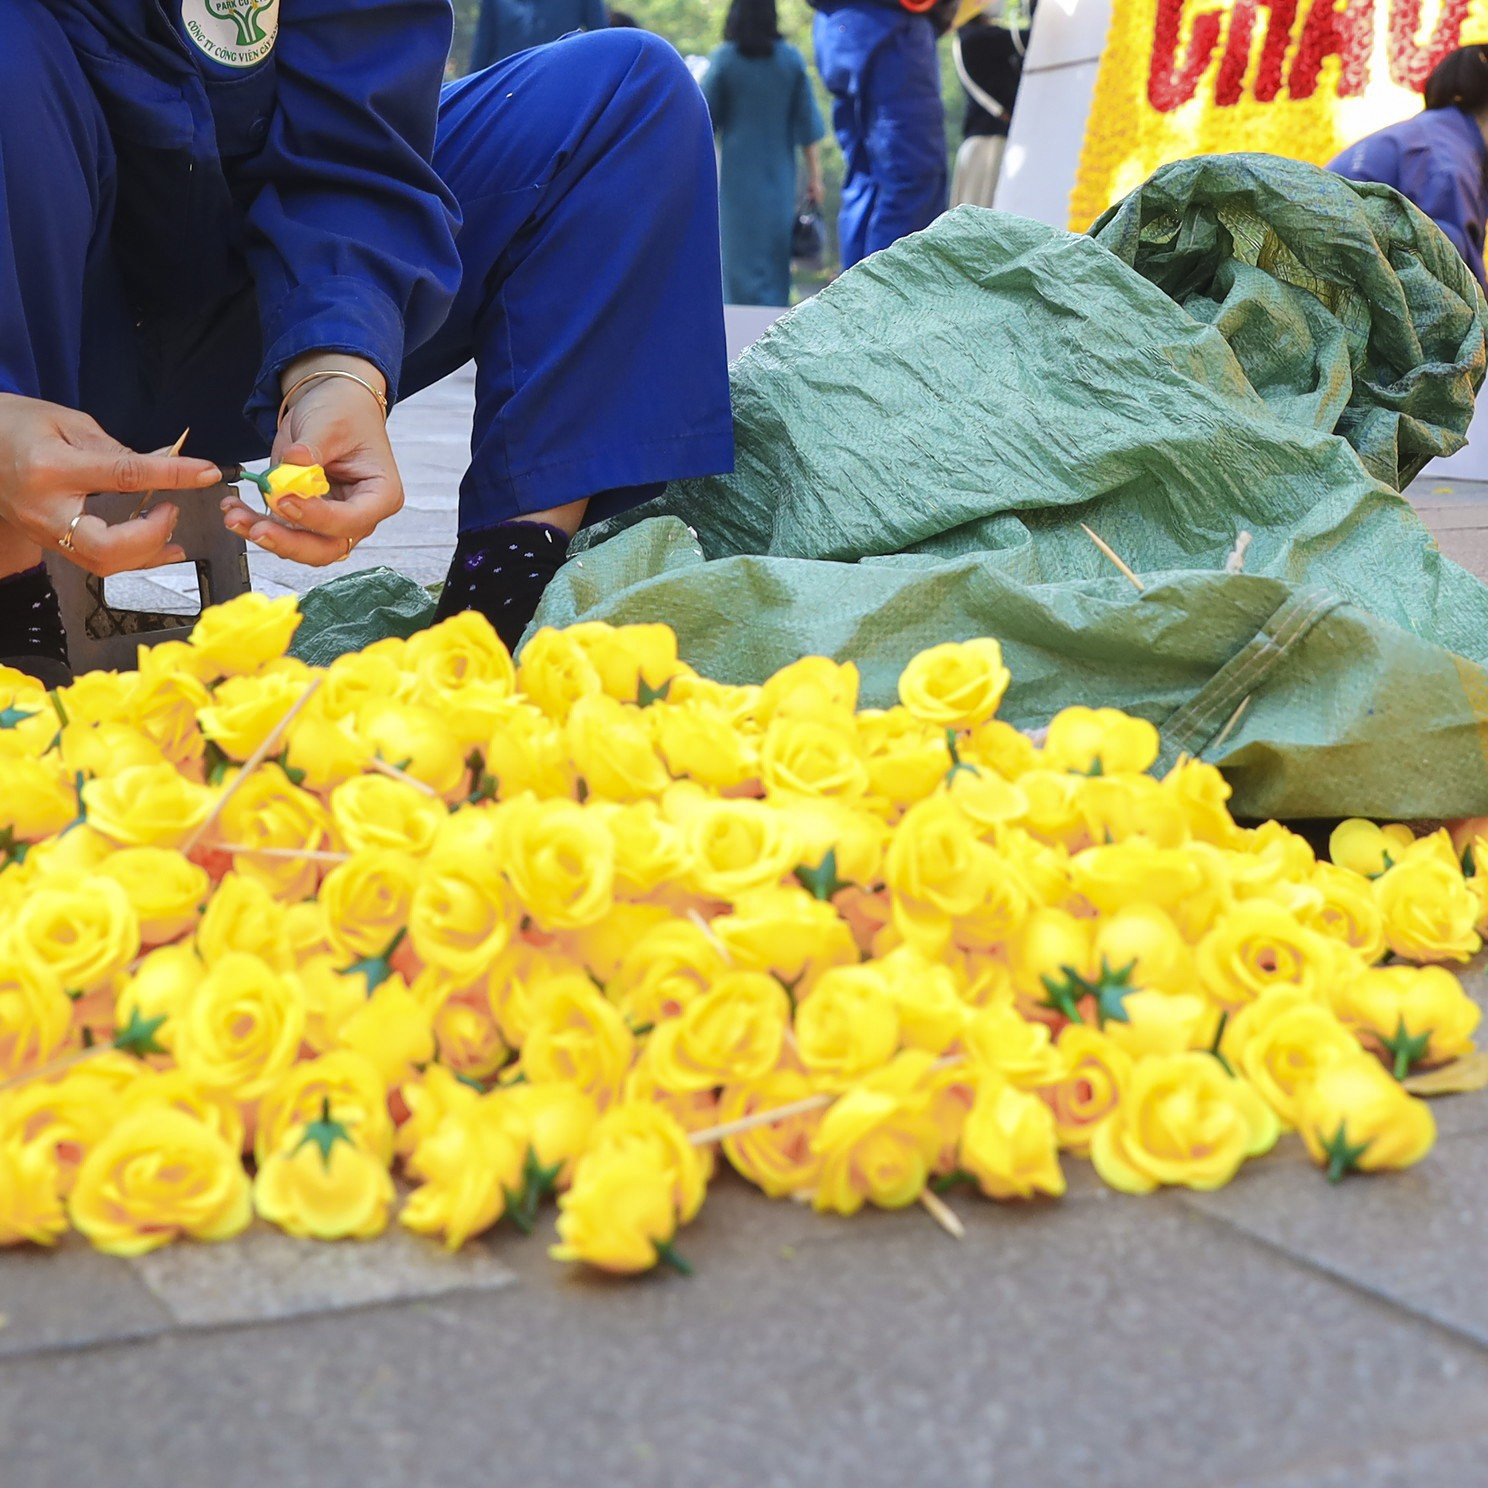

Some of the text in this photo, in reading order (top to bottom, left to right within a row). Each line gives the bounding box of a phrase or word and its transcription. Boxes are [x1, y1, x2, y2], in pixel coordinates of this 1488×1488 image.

[216, 0, 237, 11] PARK
[204, 39, 216, 52] TY
[215, 46, 236, 62] CÔNG
[238, 49, 259, 63] VIÊN
